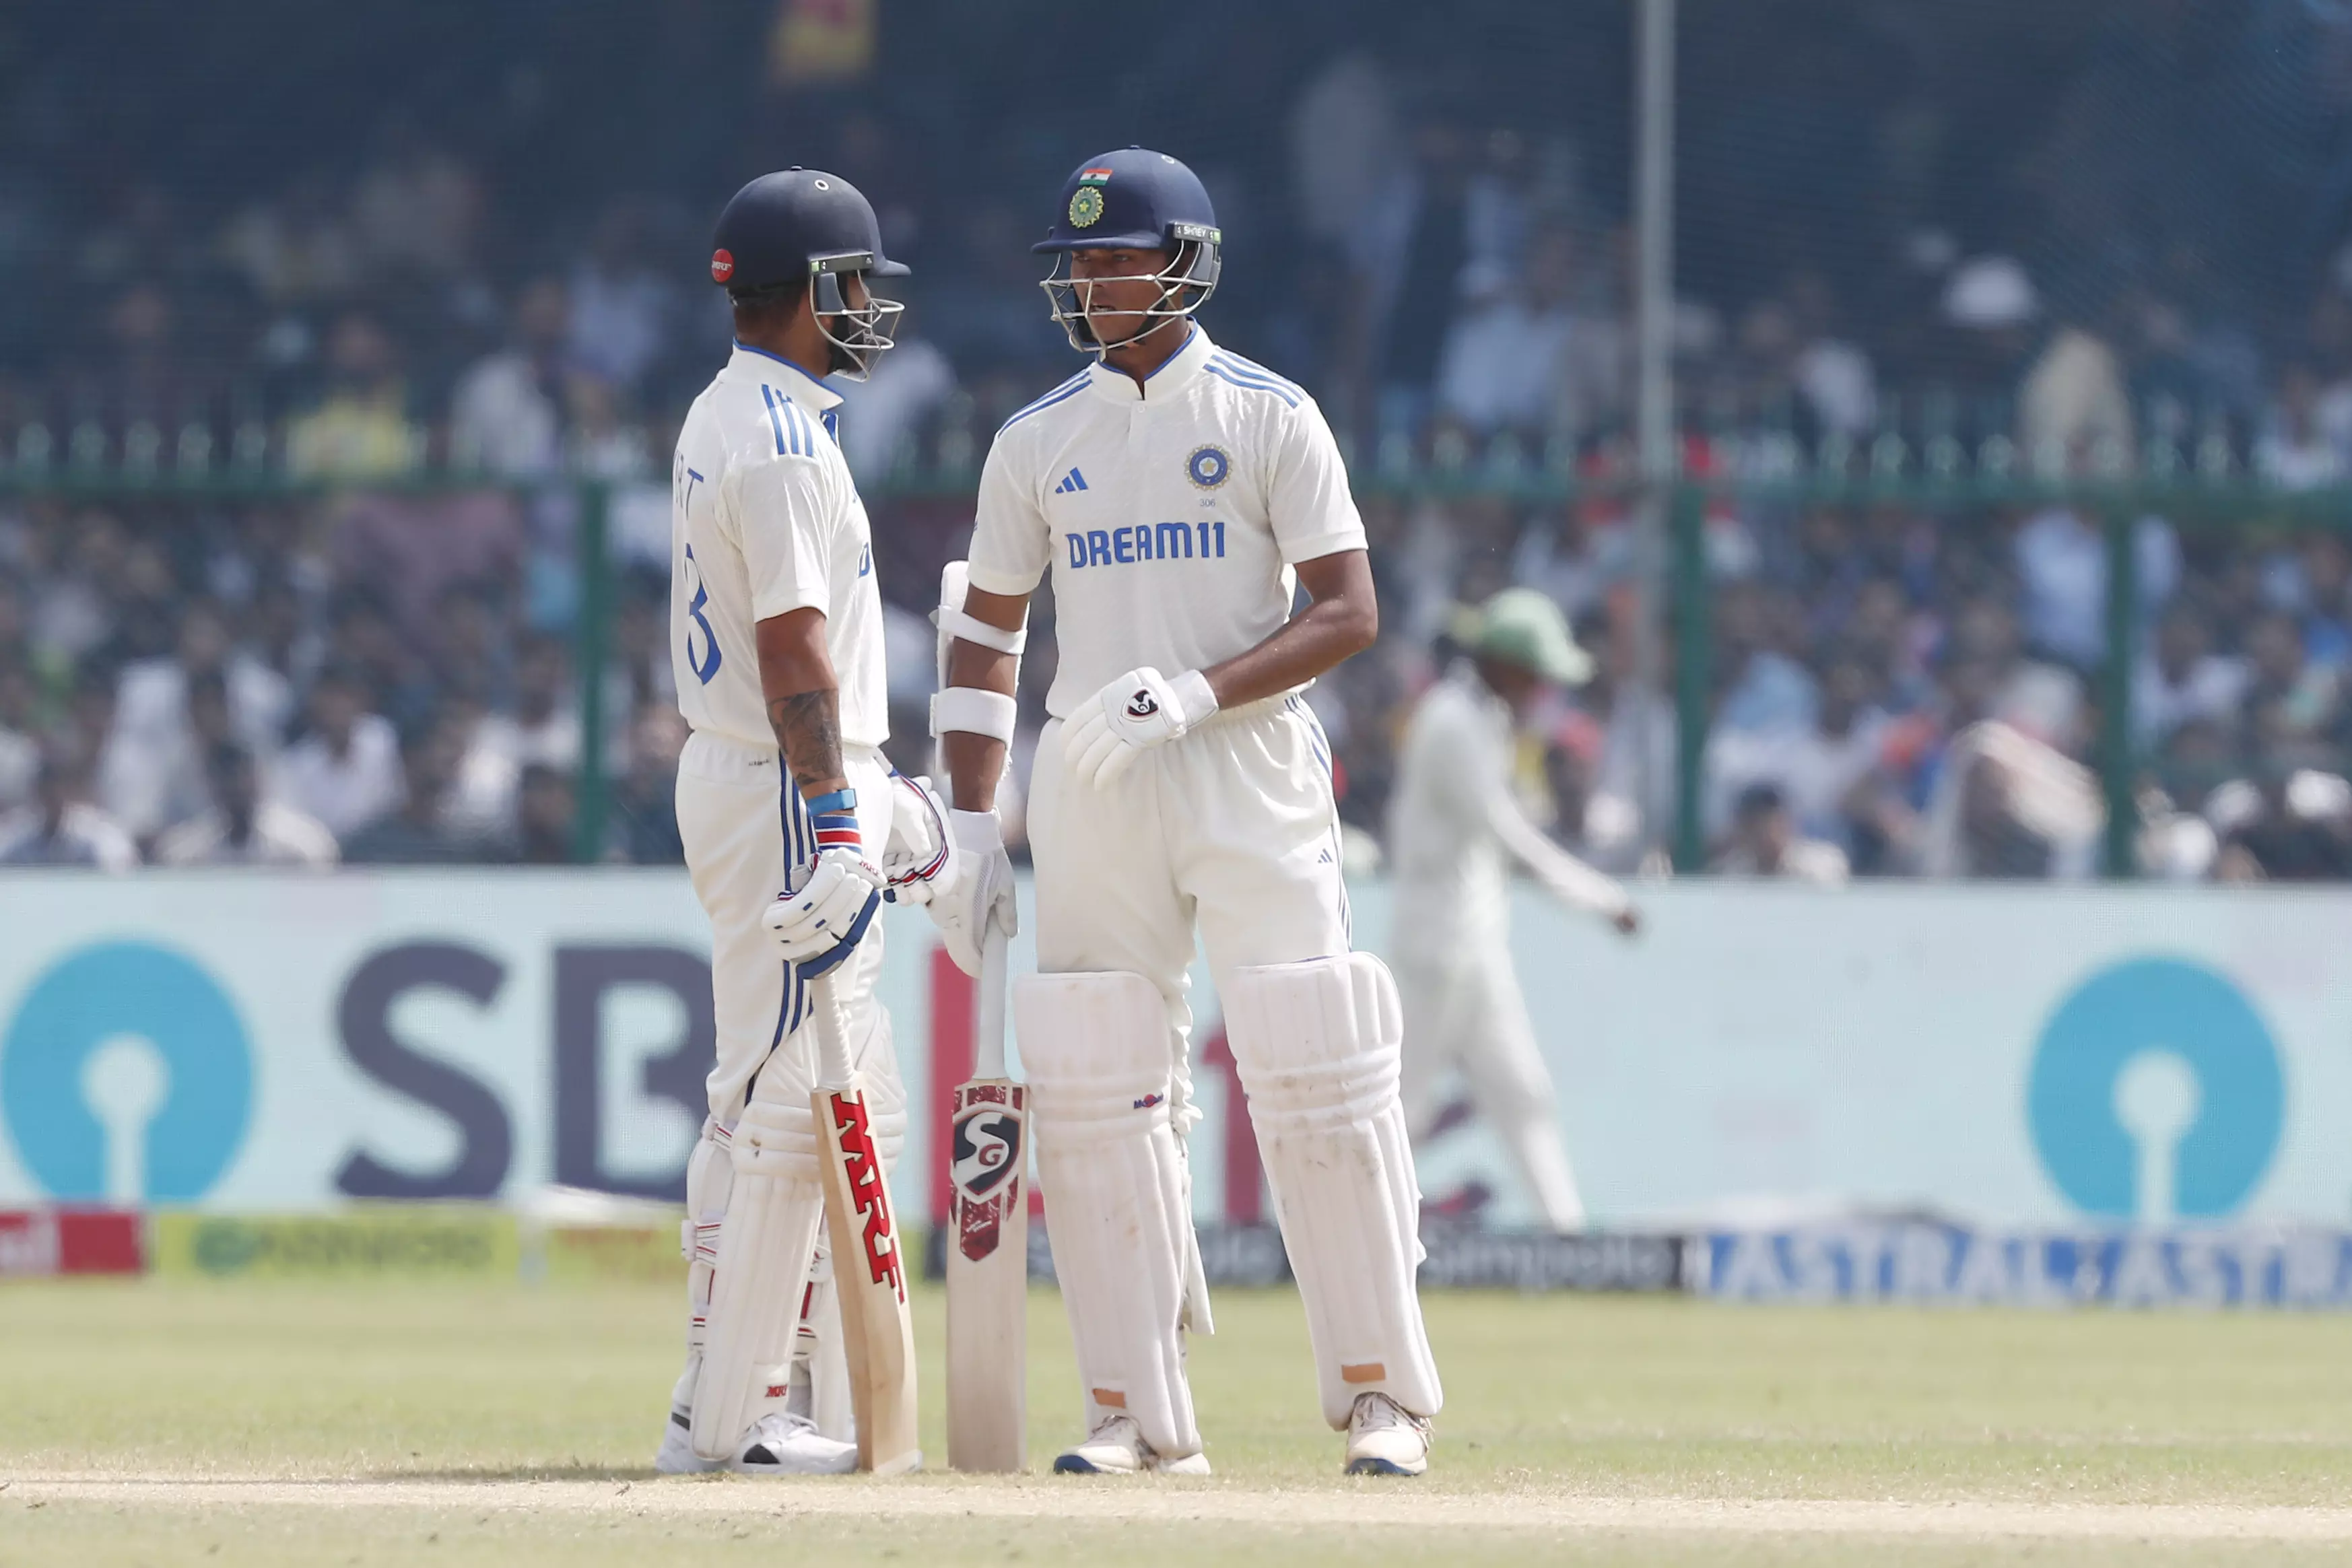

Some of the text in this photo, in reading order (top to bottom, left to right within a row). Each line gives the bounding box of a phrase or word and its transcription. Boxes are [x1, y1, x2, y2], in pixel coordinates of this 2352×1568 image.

[1200, 499, 1216, 507] 306
[1065, 522, 1225, 569] DREAM11
[951, 1112, 1010, 1189] SG
[830, 1089, 906, 1305] MRF
[1716, 1231, 2077, 1306] ASTRAL
